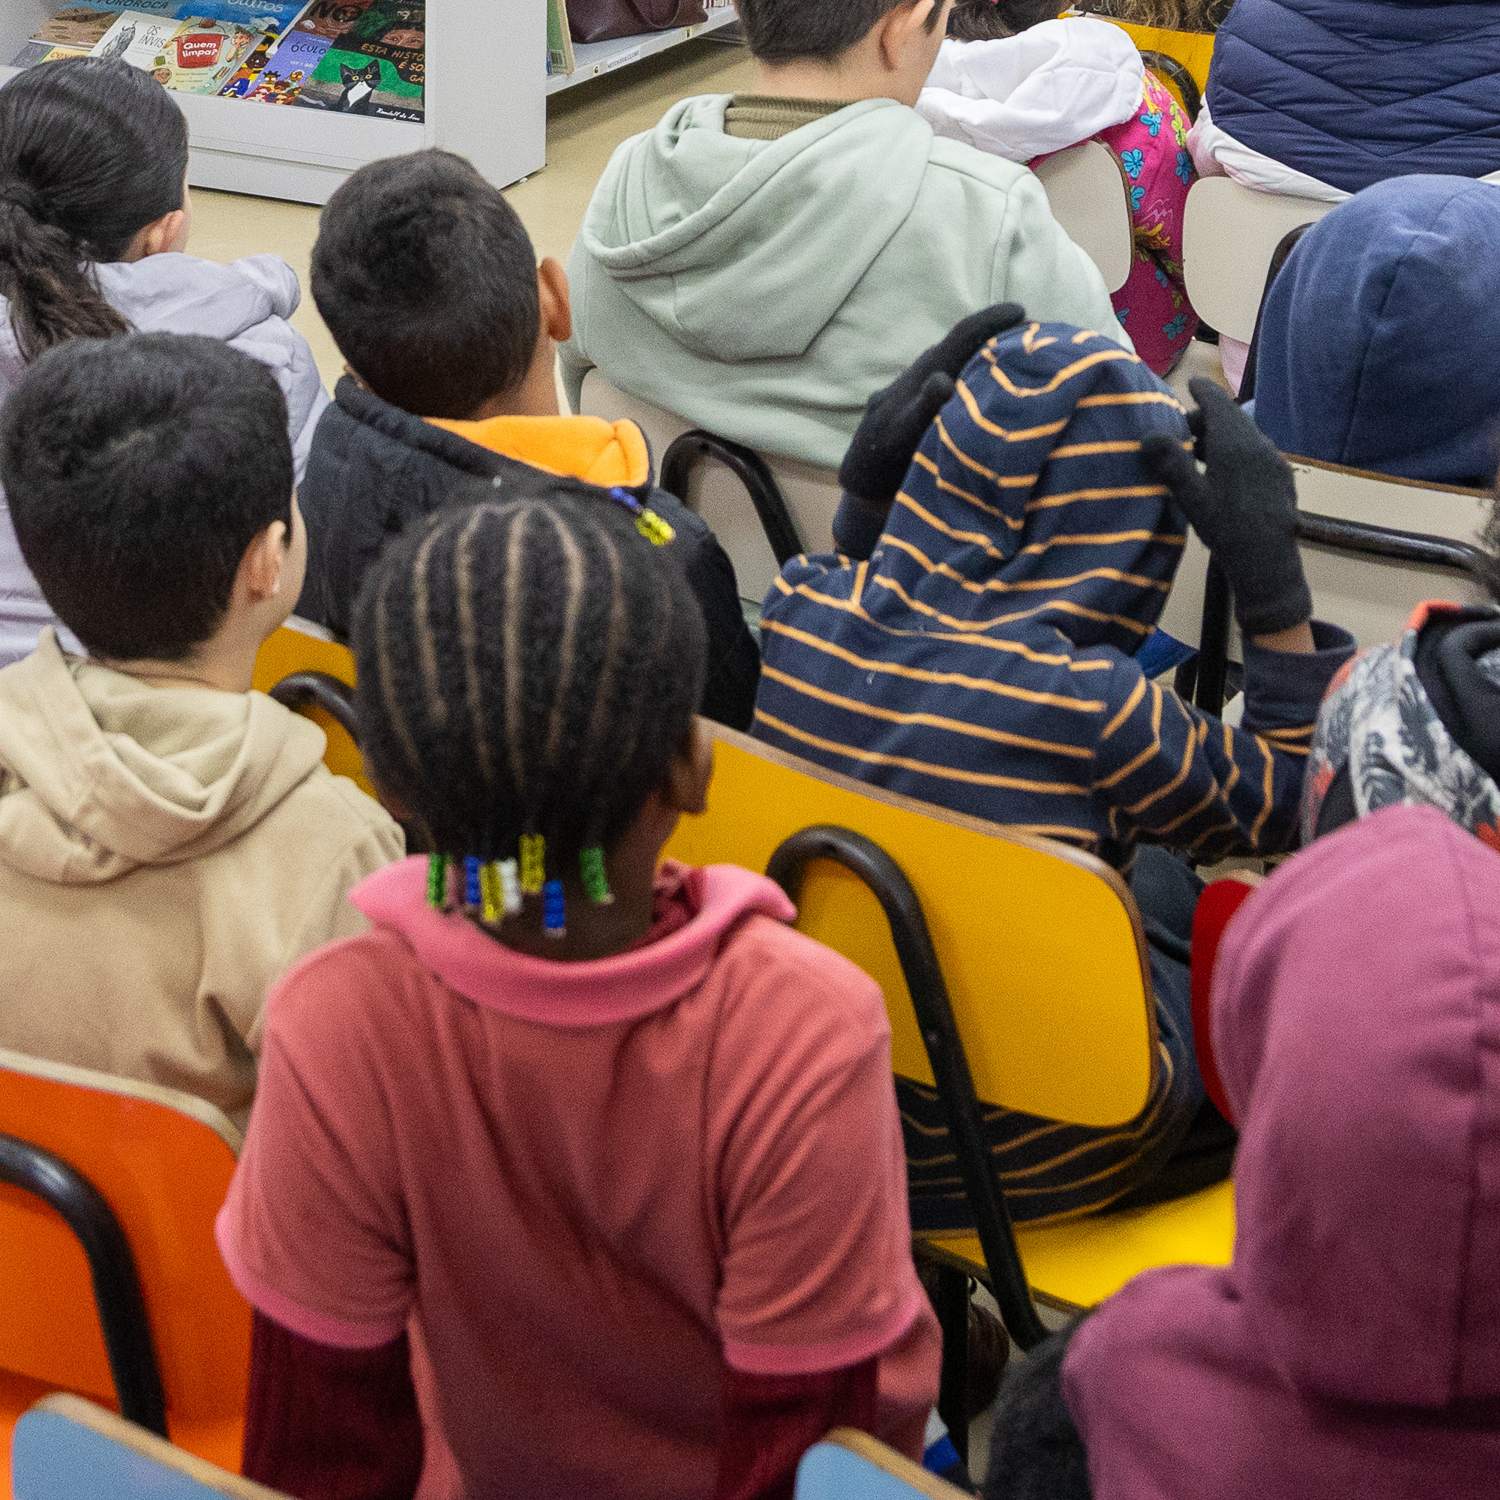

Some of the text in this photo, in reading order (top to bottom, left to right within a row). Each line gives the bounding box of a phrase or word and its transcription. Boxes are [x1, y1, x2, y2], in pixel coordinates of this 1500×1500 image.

[147, 25, 162, 36] OS
[183, 42, 218, 51] Quem
[361, 43, 388, 56] ESTA
[182, 48, 218, 58] limpa?
[398, 59, 407, 70] É
